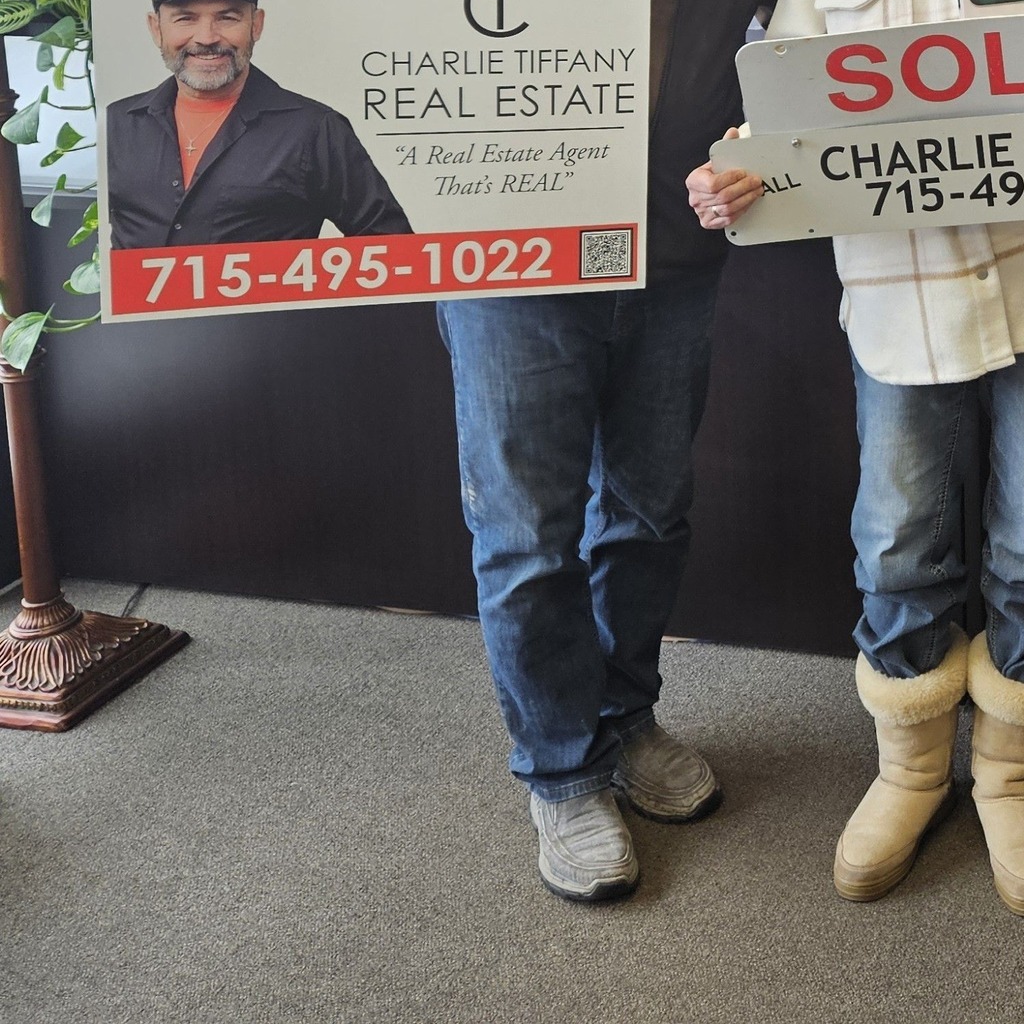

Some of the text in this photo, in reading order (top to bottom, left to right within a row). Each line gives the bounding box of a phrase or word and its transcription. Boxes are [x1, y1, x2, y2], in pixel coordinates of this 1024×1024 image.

[361, 48, 636, 77] CHARLIE TIFFANY
[364, 83, 635, 120] REAL ESTATE
[425, 142, 474, 165] Real
[480, 143, 543, 164] Estate
[548, 141, 611, 167] Agent
[819, 132, 1014, 182] CHARLIE
[434, 174, 493, 196] That’s
[761, 173, 802, 196] ALL
[141, 237, 553, 304] 715-495-1022
